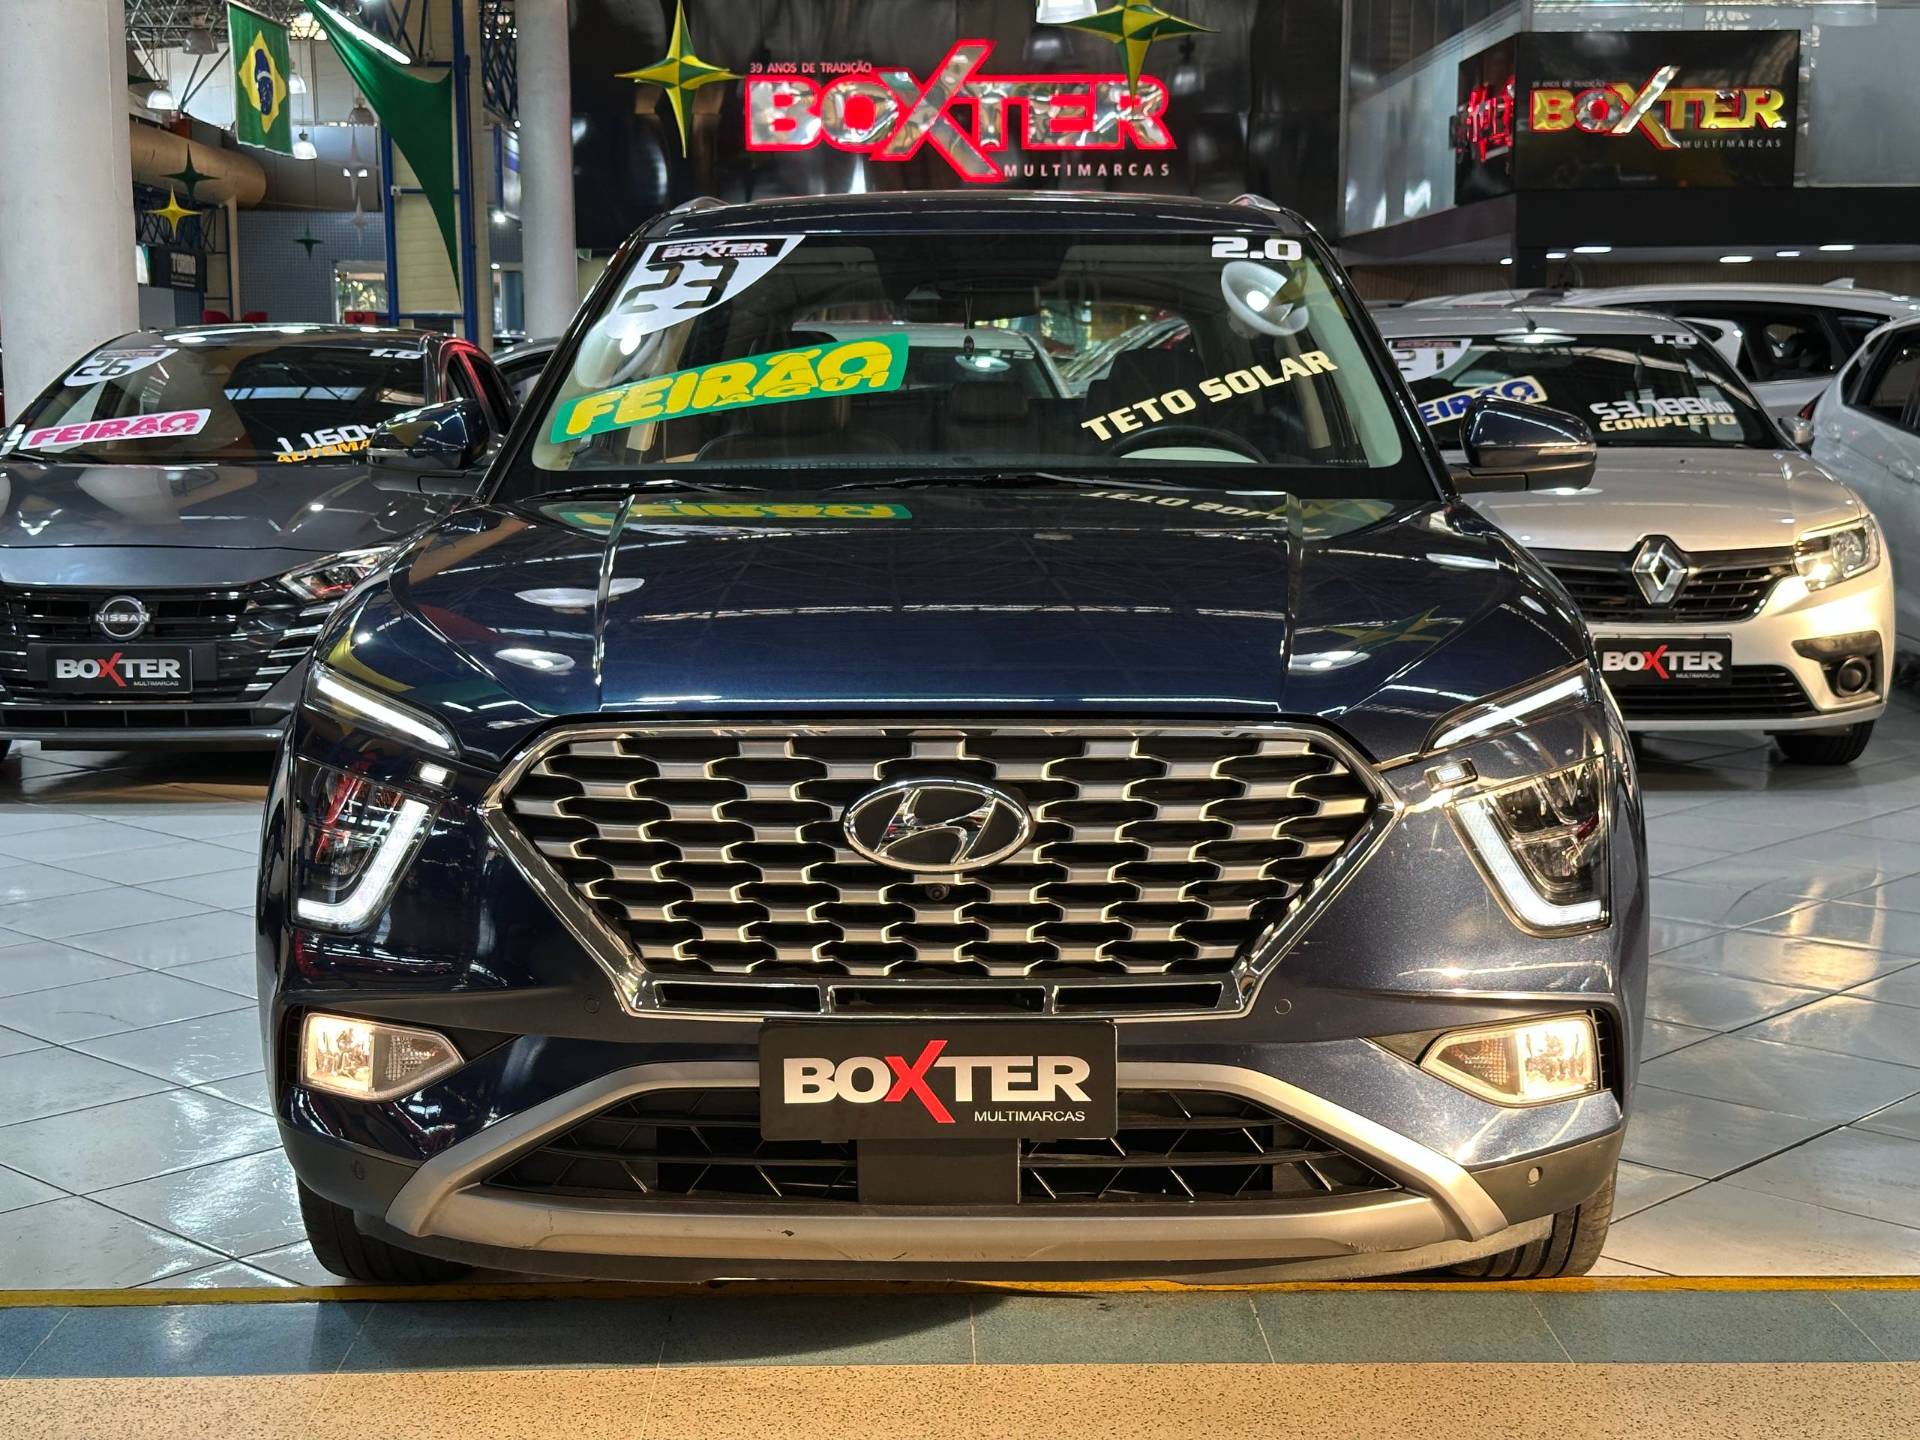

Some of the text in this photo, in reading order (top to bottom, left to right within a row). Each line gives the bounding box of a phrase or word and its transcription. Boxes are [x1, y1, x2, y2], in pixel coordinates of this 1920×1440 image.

[750, 60, 872, 74] 39 ANOS DE TRADIÇÃO
[745, 39, 1177, 183] BOXTER
[1530, 65, 1788, 150] BOXTER
[1682, 139, 1782, 149] MULTIMARCAS
[1003, 164, 1172, 178] MULTIMARCAS
[661, 240, 768, 258] BOXTER
[1211, 236, 1302, 261] 2.0
[616, 258, 740, 316] 23
[1651, 335, 1699, 345] 1.0
[369, 349, 422, 359] 1.6
[566, 341, 892, 435] FEIRÃO
[1081, 350, 1338, 441] TETO SOLAR
[29, 412, 200, 446] FEIRÃO
[1599, 414, 1737, 432] COMPLETO
[95, 613, 149, 622] NISSAN
[56, 652, 181, 687] BOXTER
[1602, 645, 1723, 679] BOXTER
[784, 1040, 1092, 1124] BOXTER
[974, 1110, 1086, 1122] MULTIMARCAS
